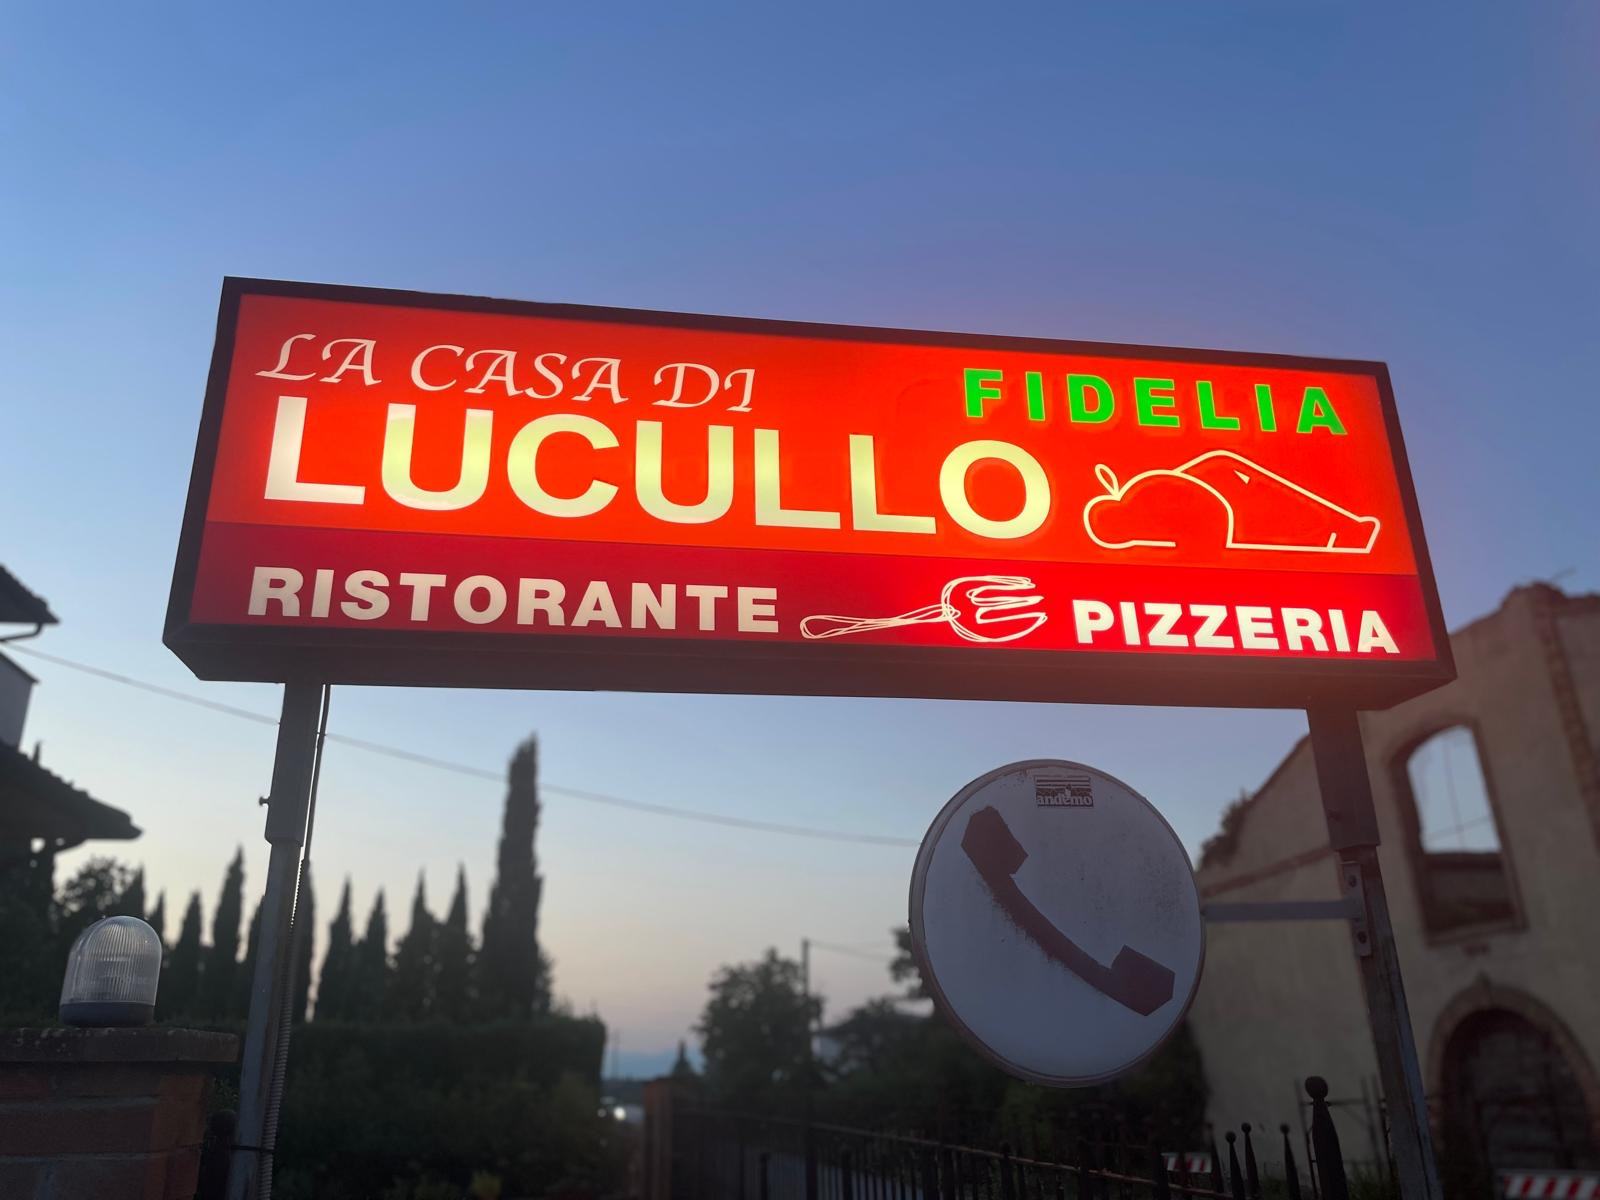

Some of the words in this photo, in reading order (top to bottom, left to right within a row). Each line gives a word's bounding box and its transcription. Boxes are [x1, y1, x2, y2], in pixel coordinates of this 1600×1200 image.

[257, 333, 381, 386] LA
[410, 343, 629, 405] CASA
[653, 362, 756, 413] DI
[964, 368, 1348, 435] FIDELIA
[263, 395, 1051, 540] LUCULLO
[247, 566, 779, 633] RISTORANTE
[1072, 599, 1400, 654] PIZZERIA
